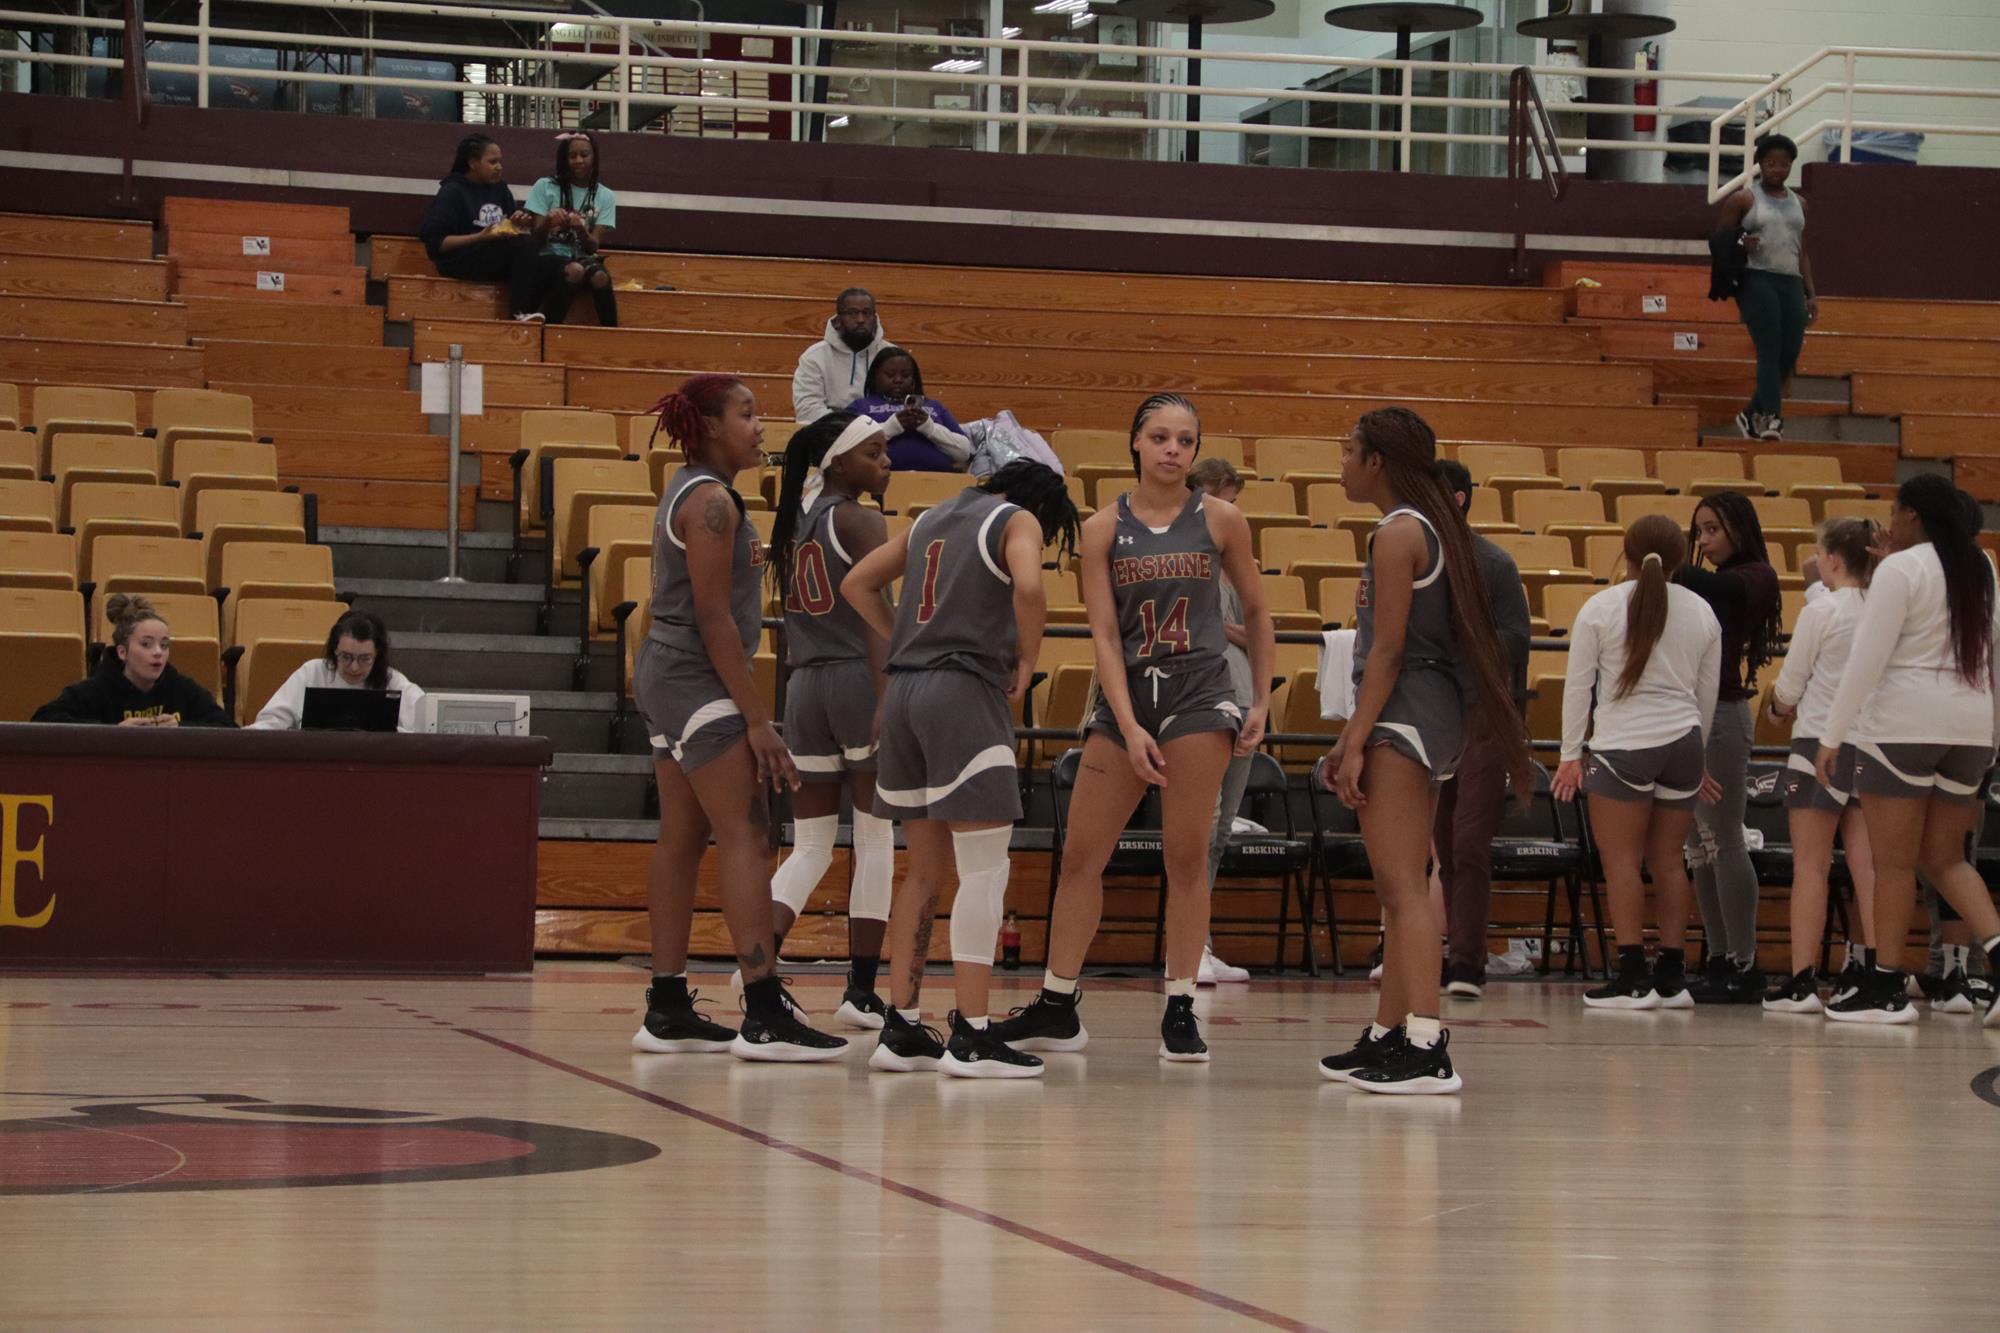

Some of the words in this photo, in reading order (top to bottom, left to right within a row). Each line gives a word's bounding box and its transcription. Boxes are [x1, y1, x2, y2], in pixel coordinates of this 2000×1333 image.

[1113, 552, 1211, 587] ERSKINE
[917, 539, 945, 624] 1
[1137, 597, 1190, 657] 14
[1118, 840, 1162, 850] ERSKINE
[1242, 846, 1286, 855] ERSKINE
[1516, 847, 1560, 856] ERSKINE
